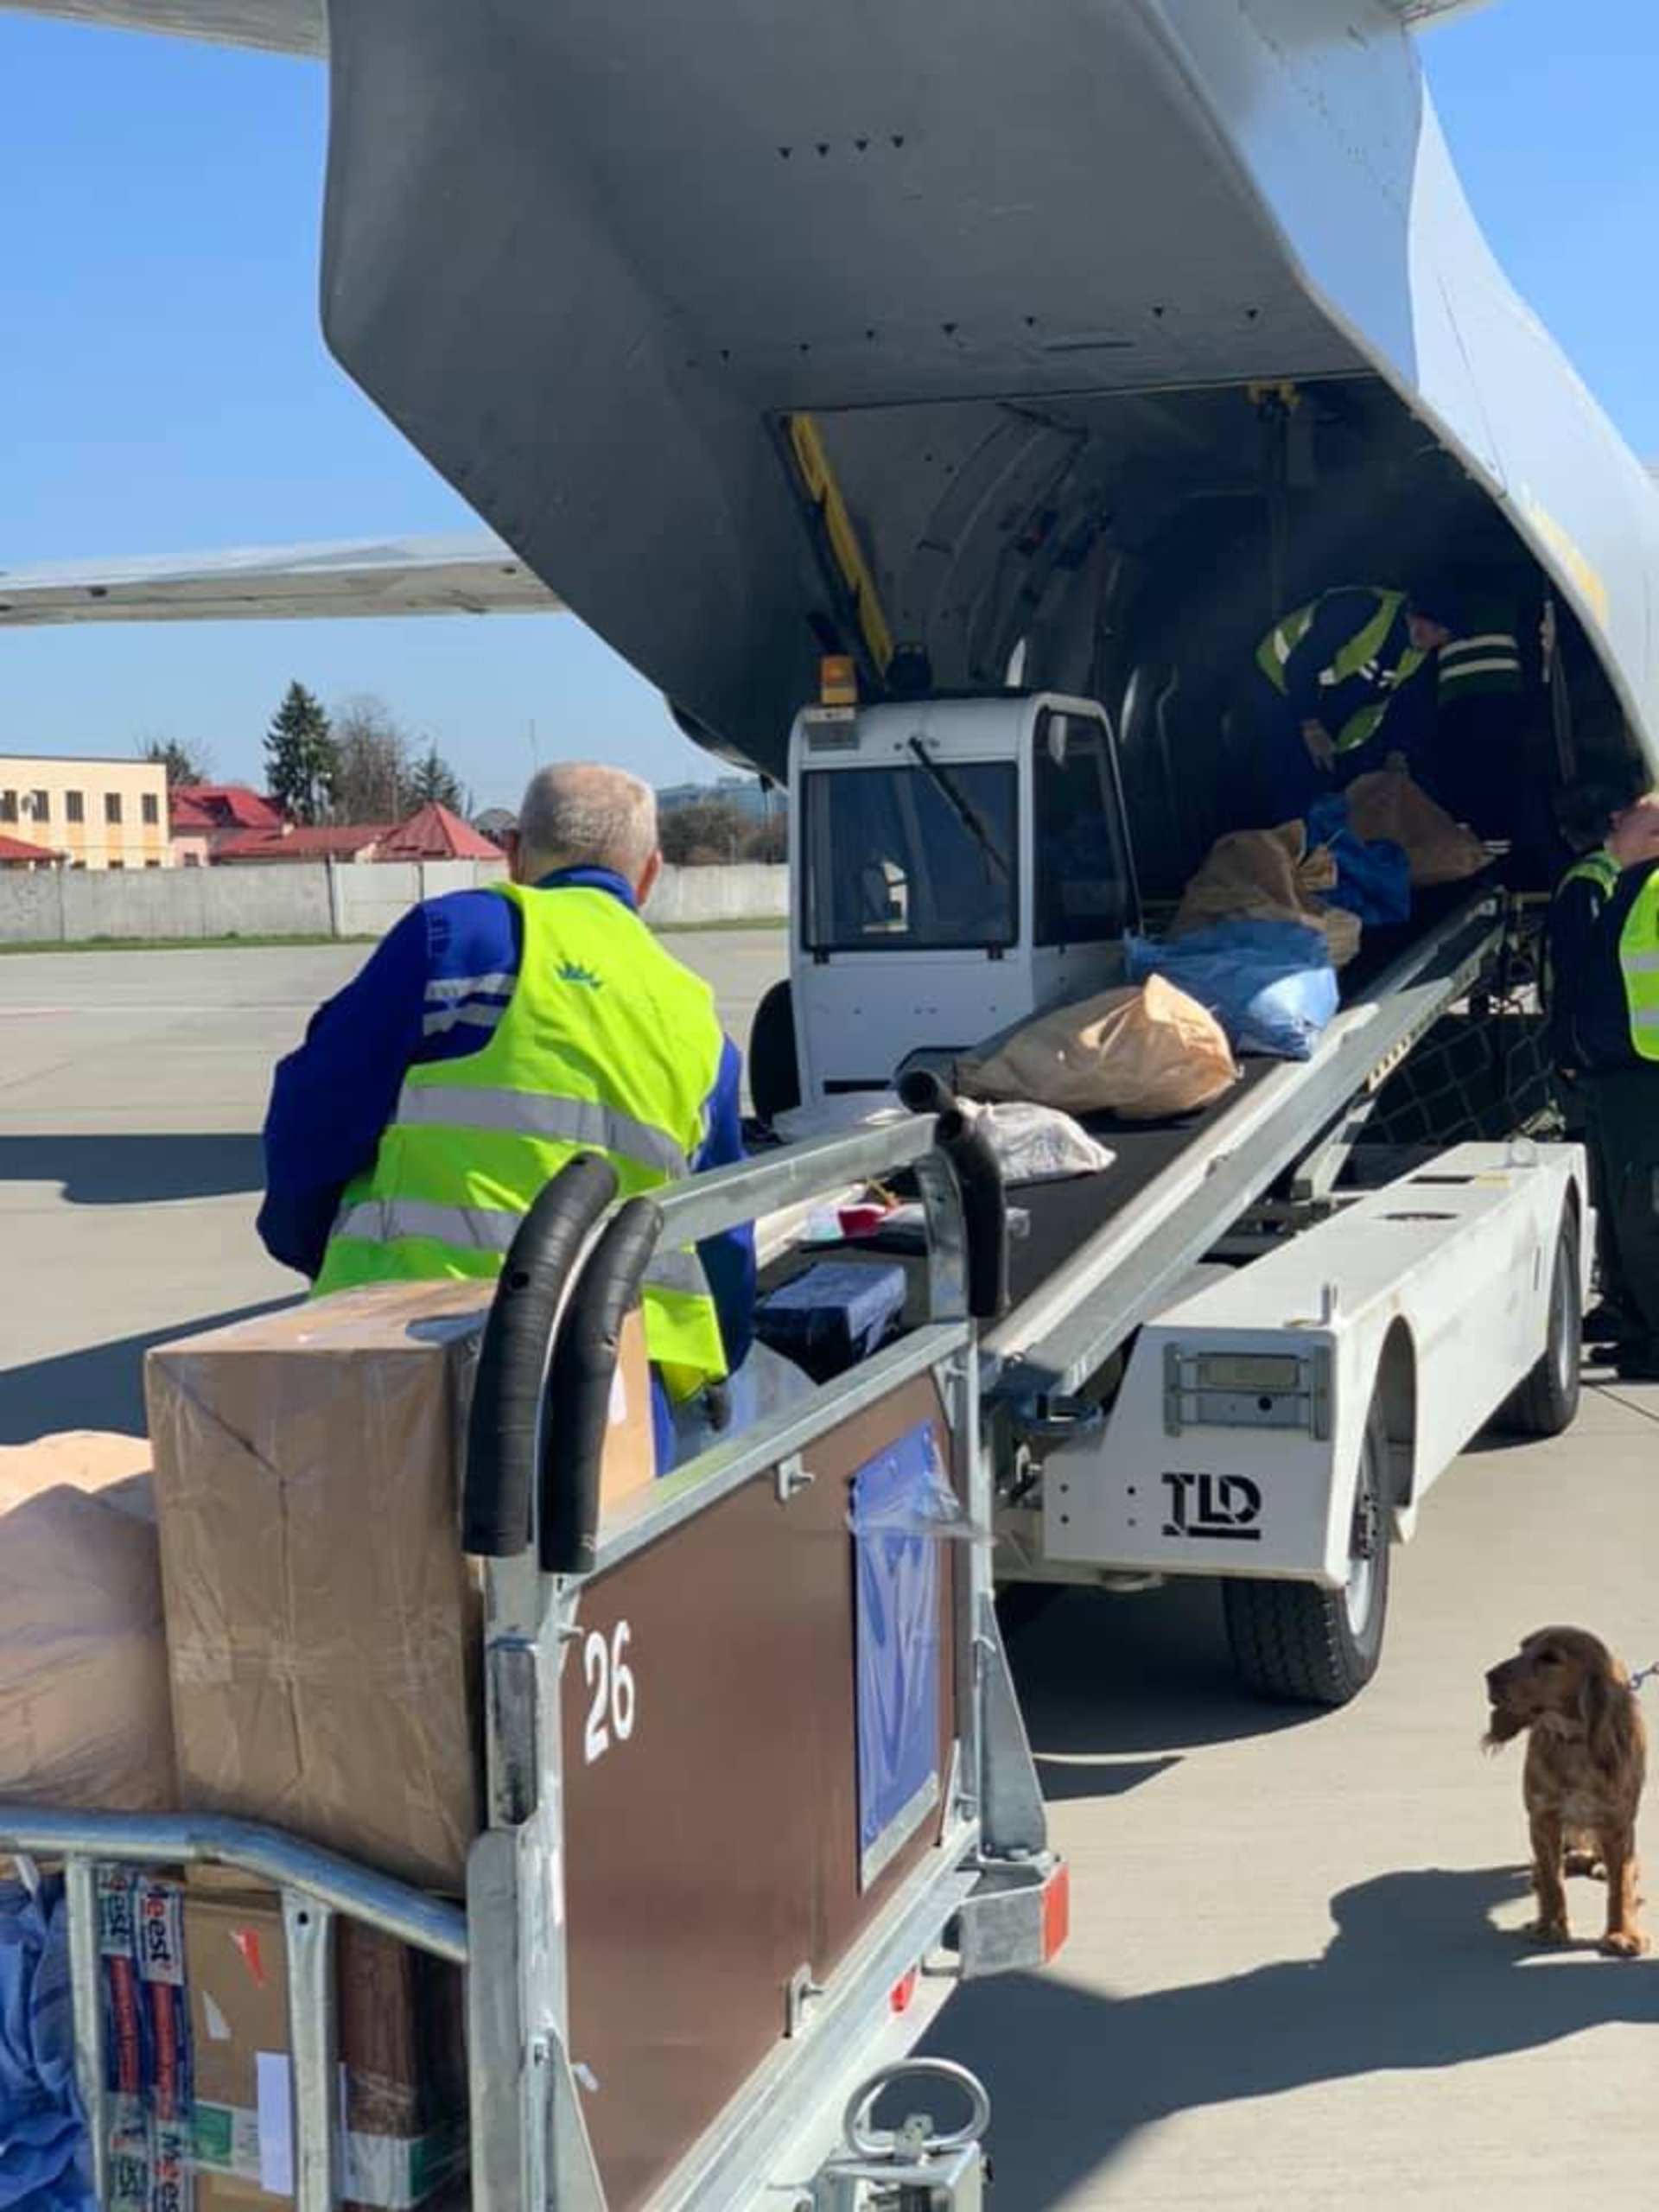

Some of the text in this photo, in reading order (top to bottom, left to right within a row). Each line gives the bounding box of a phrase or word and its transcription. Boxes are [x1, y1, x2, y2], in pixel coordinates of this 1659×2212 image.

[1161, 1472, 1262, 1539] TLD
[584, 1619, 635, 1764] 26
[159, 2132, 183, 2212] Mees
